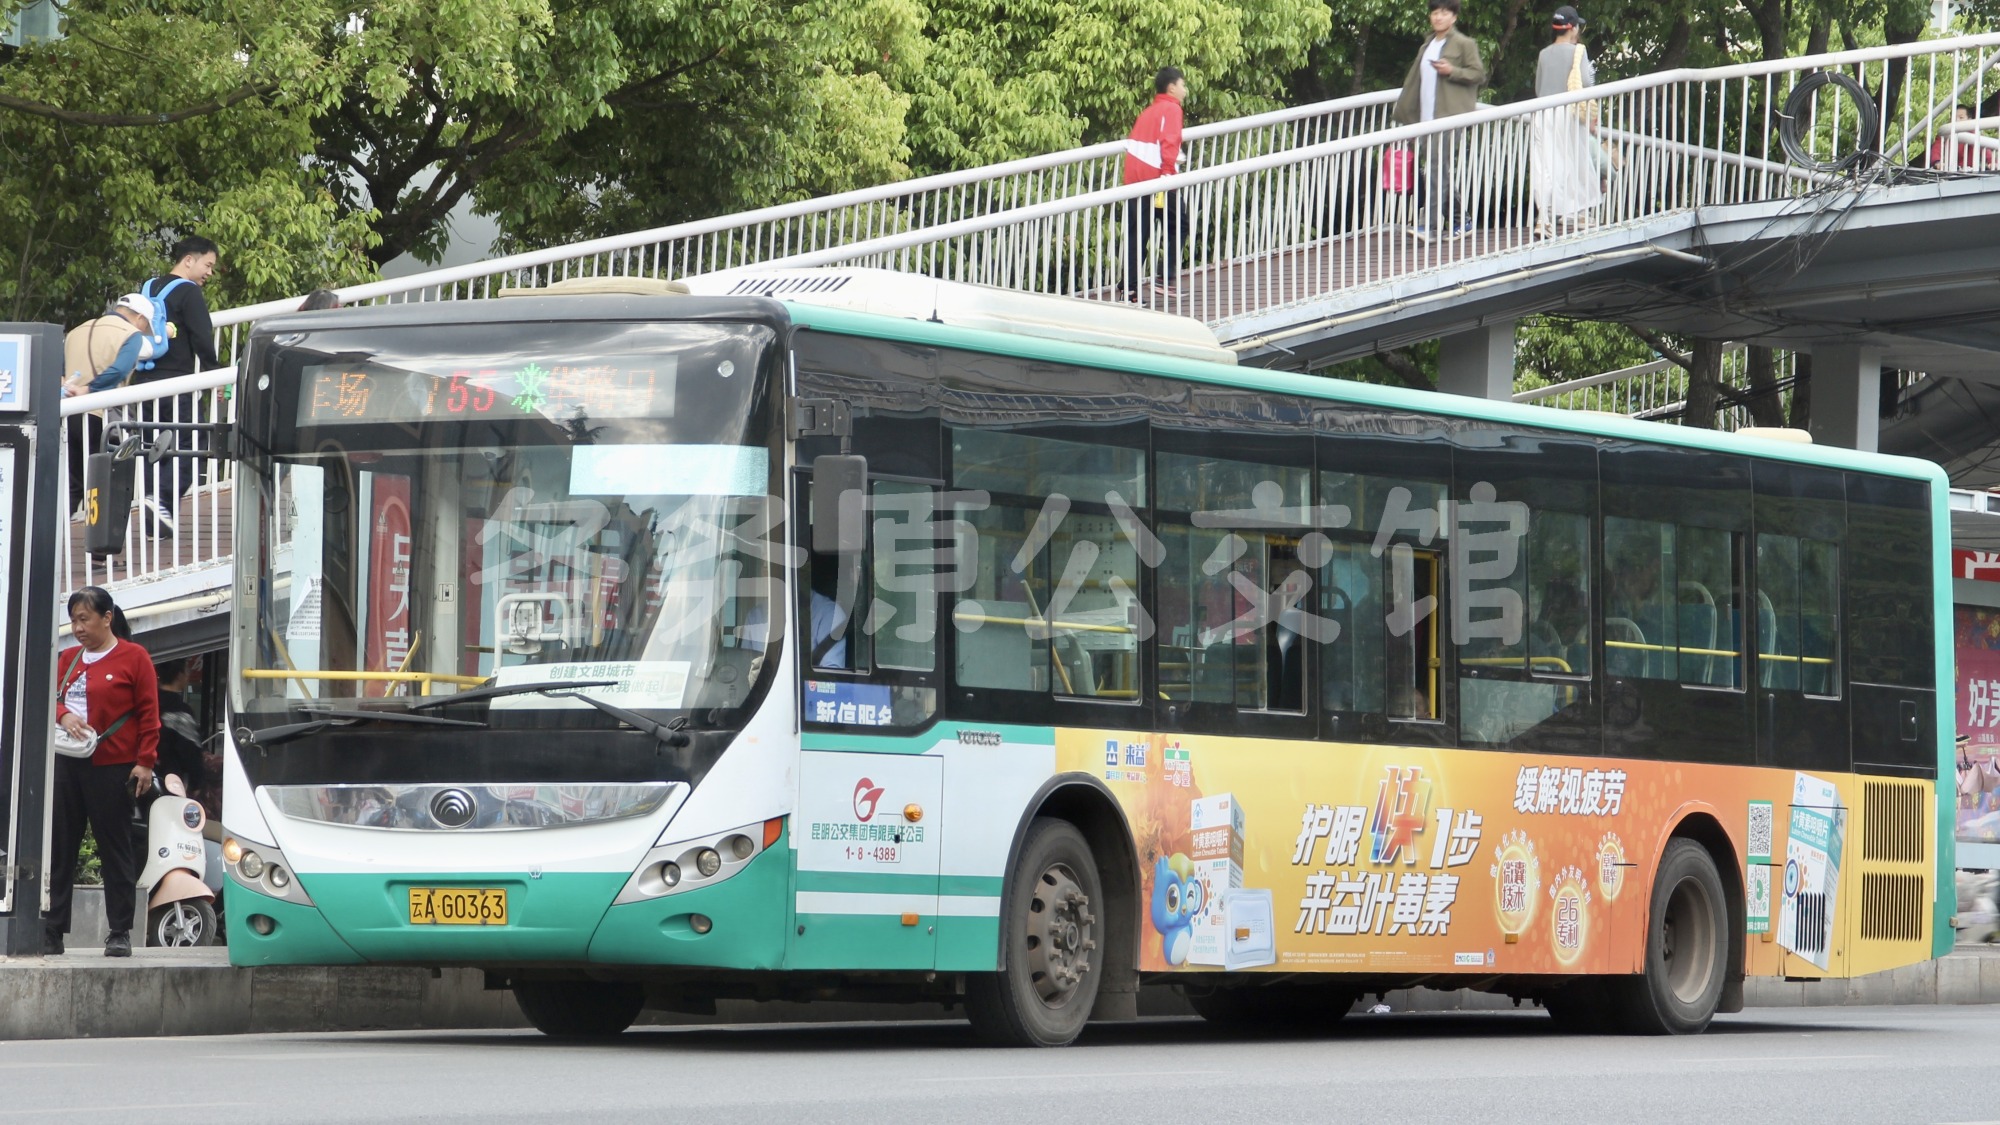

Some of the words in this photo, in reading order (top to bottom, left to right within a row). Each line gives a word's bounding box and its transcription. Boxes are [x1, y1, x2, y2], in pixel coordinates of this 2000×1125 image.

[447, 369, 497, 413] 55
[549, 664, 635, 679] 创建文明城市
[1125, 744, 1145, 766] 来益
[1513, 765, 1627, 816] 缓解视疲劳
[811, 823, 925, 843] 昆明公交集团有限责任公司
[1503, 860, 1526, 885] 微囊
[1294, 870, 1461, 936] 来益叶黄素
[1502, 886, 1525, 911] 技术
[1558, 897, 1578, 922] 26
[1558, 923, 1579, 947] 专利
